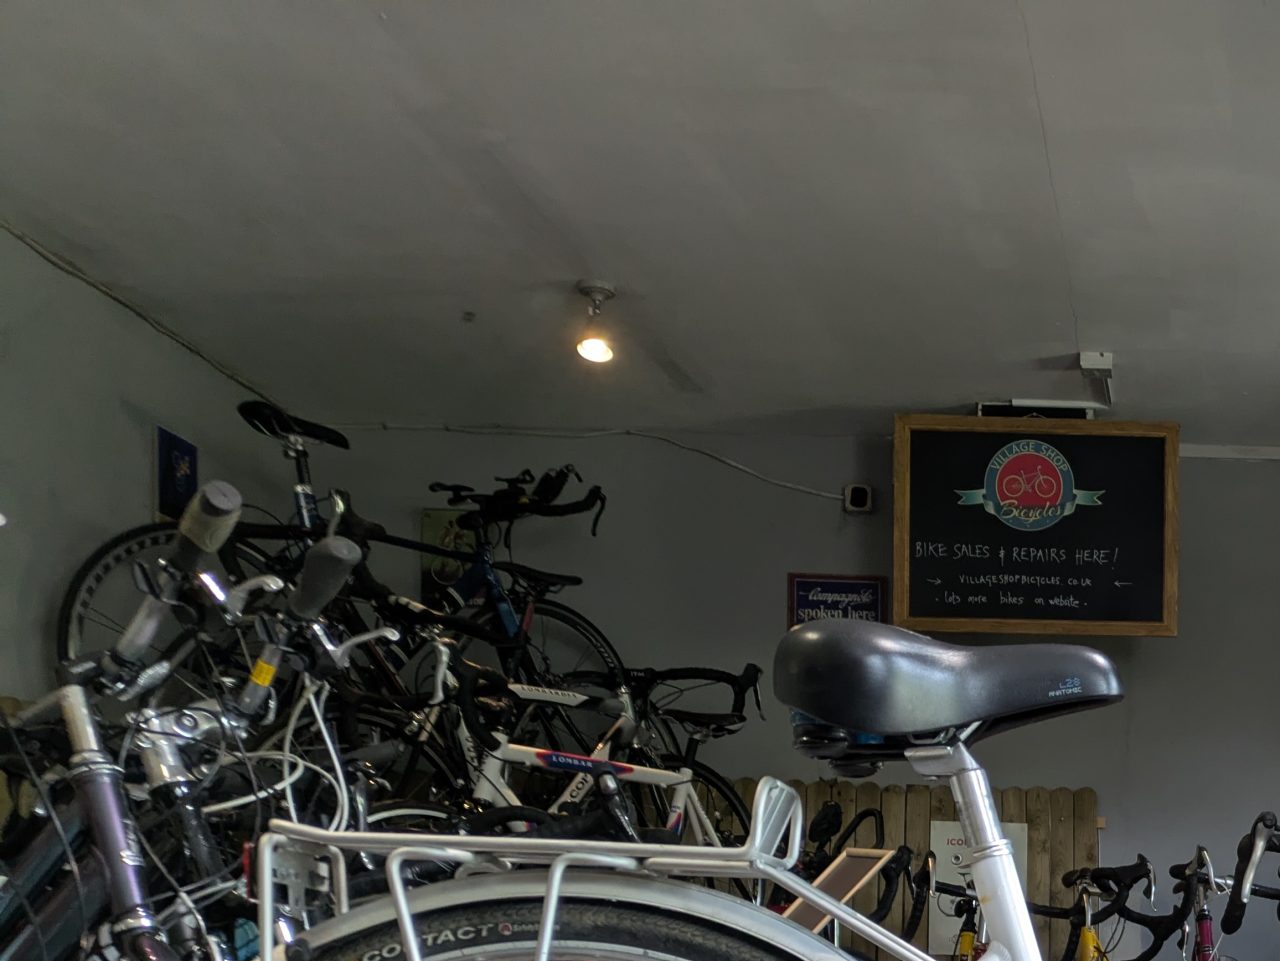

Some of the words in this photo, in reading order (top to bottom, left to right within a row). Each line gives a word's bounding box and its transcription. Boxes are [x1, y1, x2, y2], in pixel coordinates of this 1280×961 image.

[990, 441, 1036, 470] VILLAGE
[1041, 445, 1069, 472] SHOP
[1001, 499, 1061, 523] Bicycles
[915, 541, 948, 558] BIKE
[952, 543, 990, 560] SALES
[1012, 546, 1067, 564] REPAIRS
[968, 595, 988, 604] more
[1000, 591, 1024, 605] bikes
[1034, 596, 1045, 606] on
[798, 605, 843, 621] spoken
[847, 606, 876, 621] here
[552, 755, 594, 769] LOMBAR
[946, 838, 967, 846] ICO
